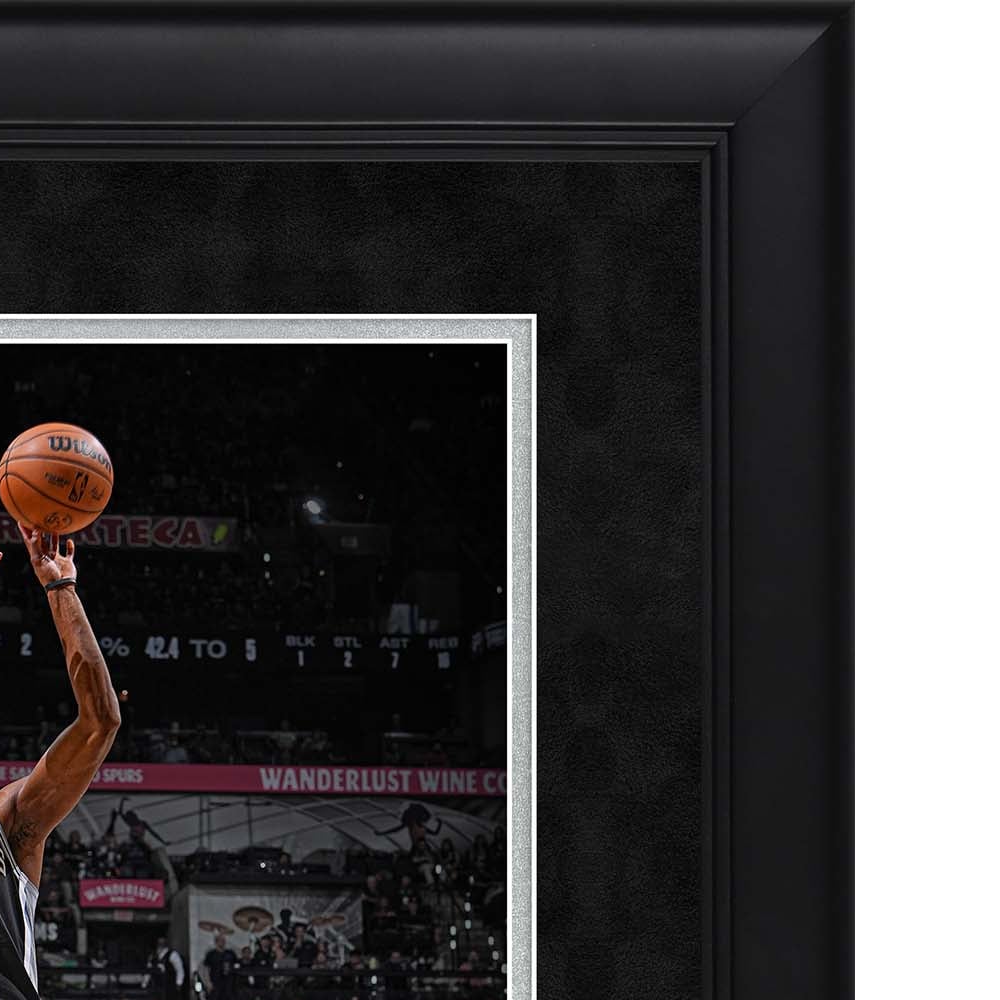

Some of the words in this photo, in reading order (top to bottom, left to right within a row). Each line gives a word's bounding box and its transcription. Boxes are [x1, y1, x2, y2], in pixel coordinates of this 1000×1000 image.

[48, 436, 111, 472] Wilson
[20, 632, 33, 656] 2
[188, 638, 228, 660] TO
[245, 637, 258, 662] 5
[297, 649, 305, 668] 1
[343, 650, 353, 669] 2
[391, 651, 401, 670] 7
[103, 768, 144, 784] SPURS
[258, 767, 412, 792] WANDERLUST
[417, 769, 478, 794] WINE
